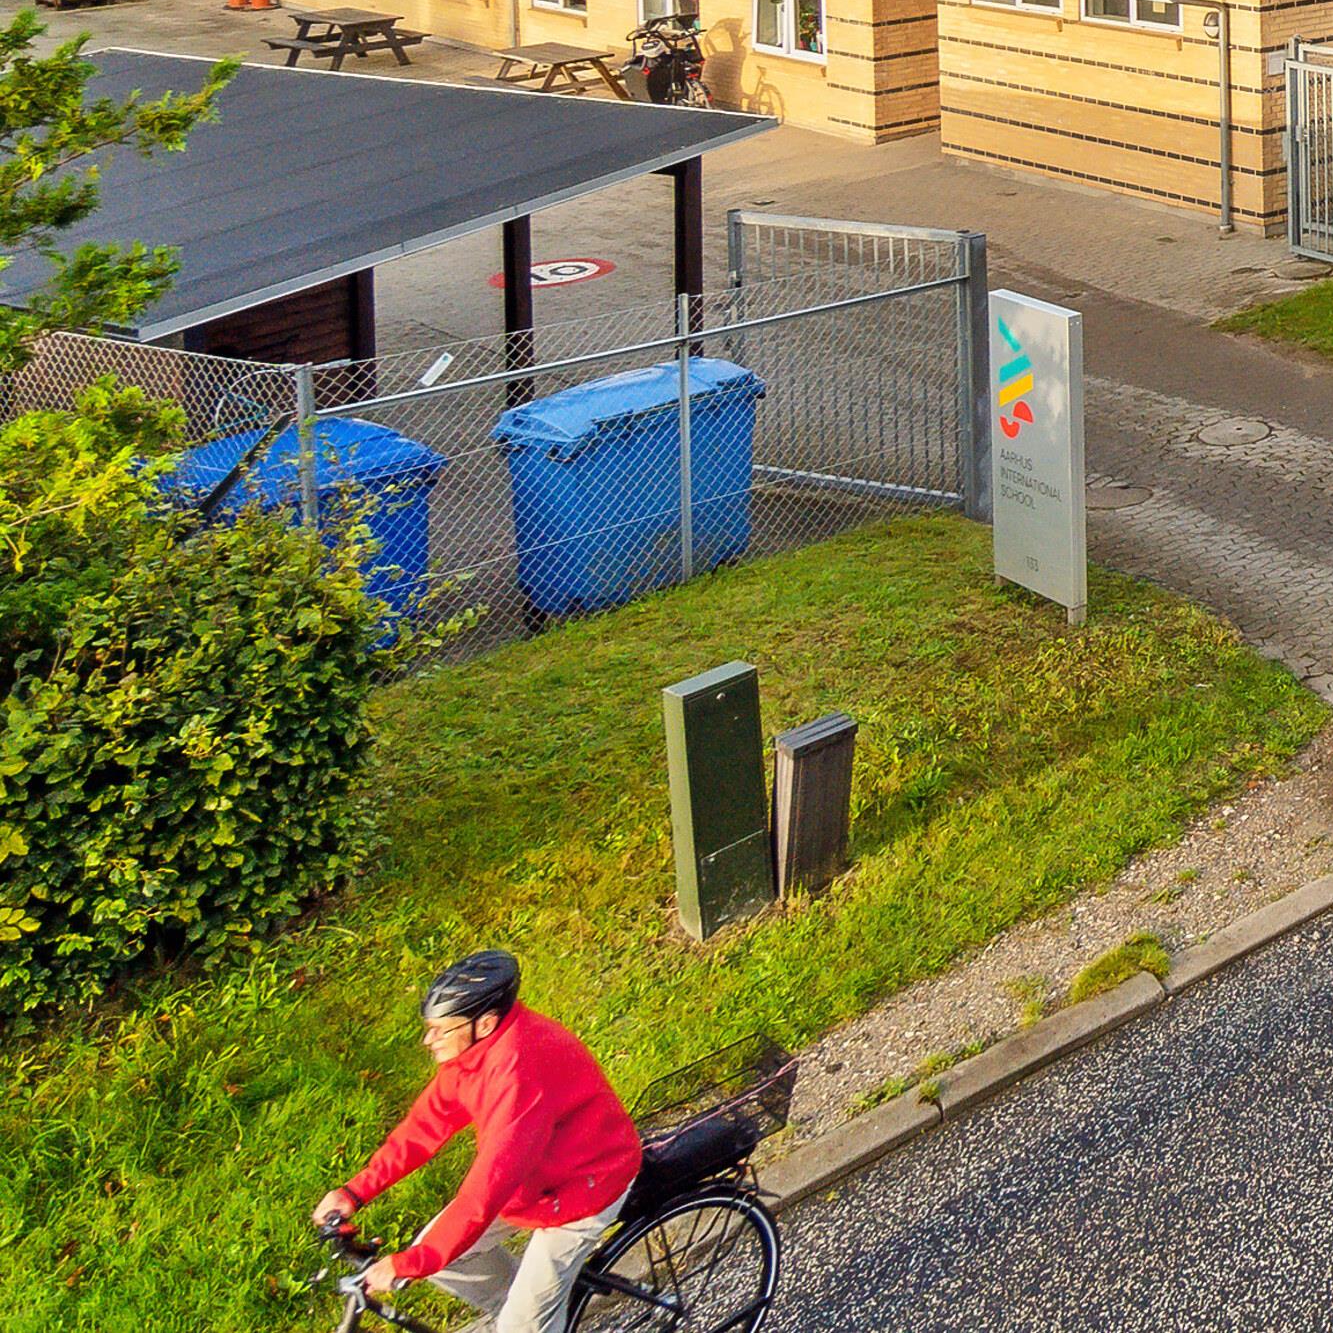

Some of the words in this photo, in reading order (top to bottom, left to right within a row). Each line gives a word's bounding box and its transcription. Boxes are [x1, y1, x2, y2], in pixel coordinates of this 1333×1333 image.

[1000, 448, 1033, 472] AARHUS
[1000, 466, 1062, 503] INTERNATIONAL
[1000, 484, 1036, 510] SCHOOL
